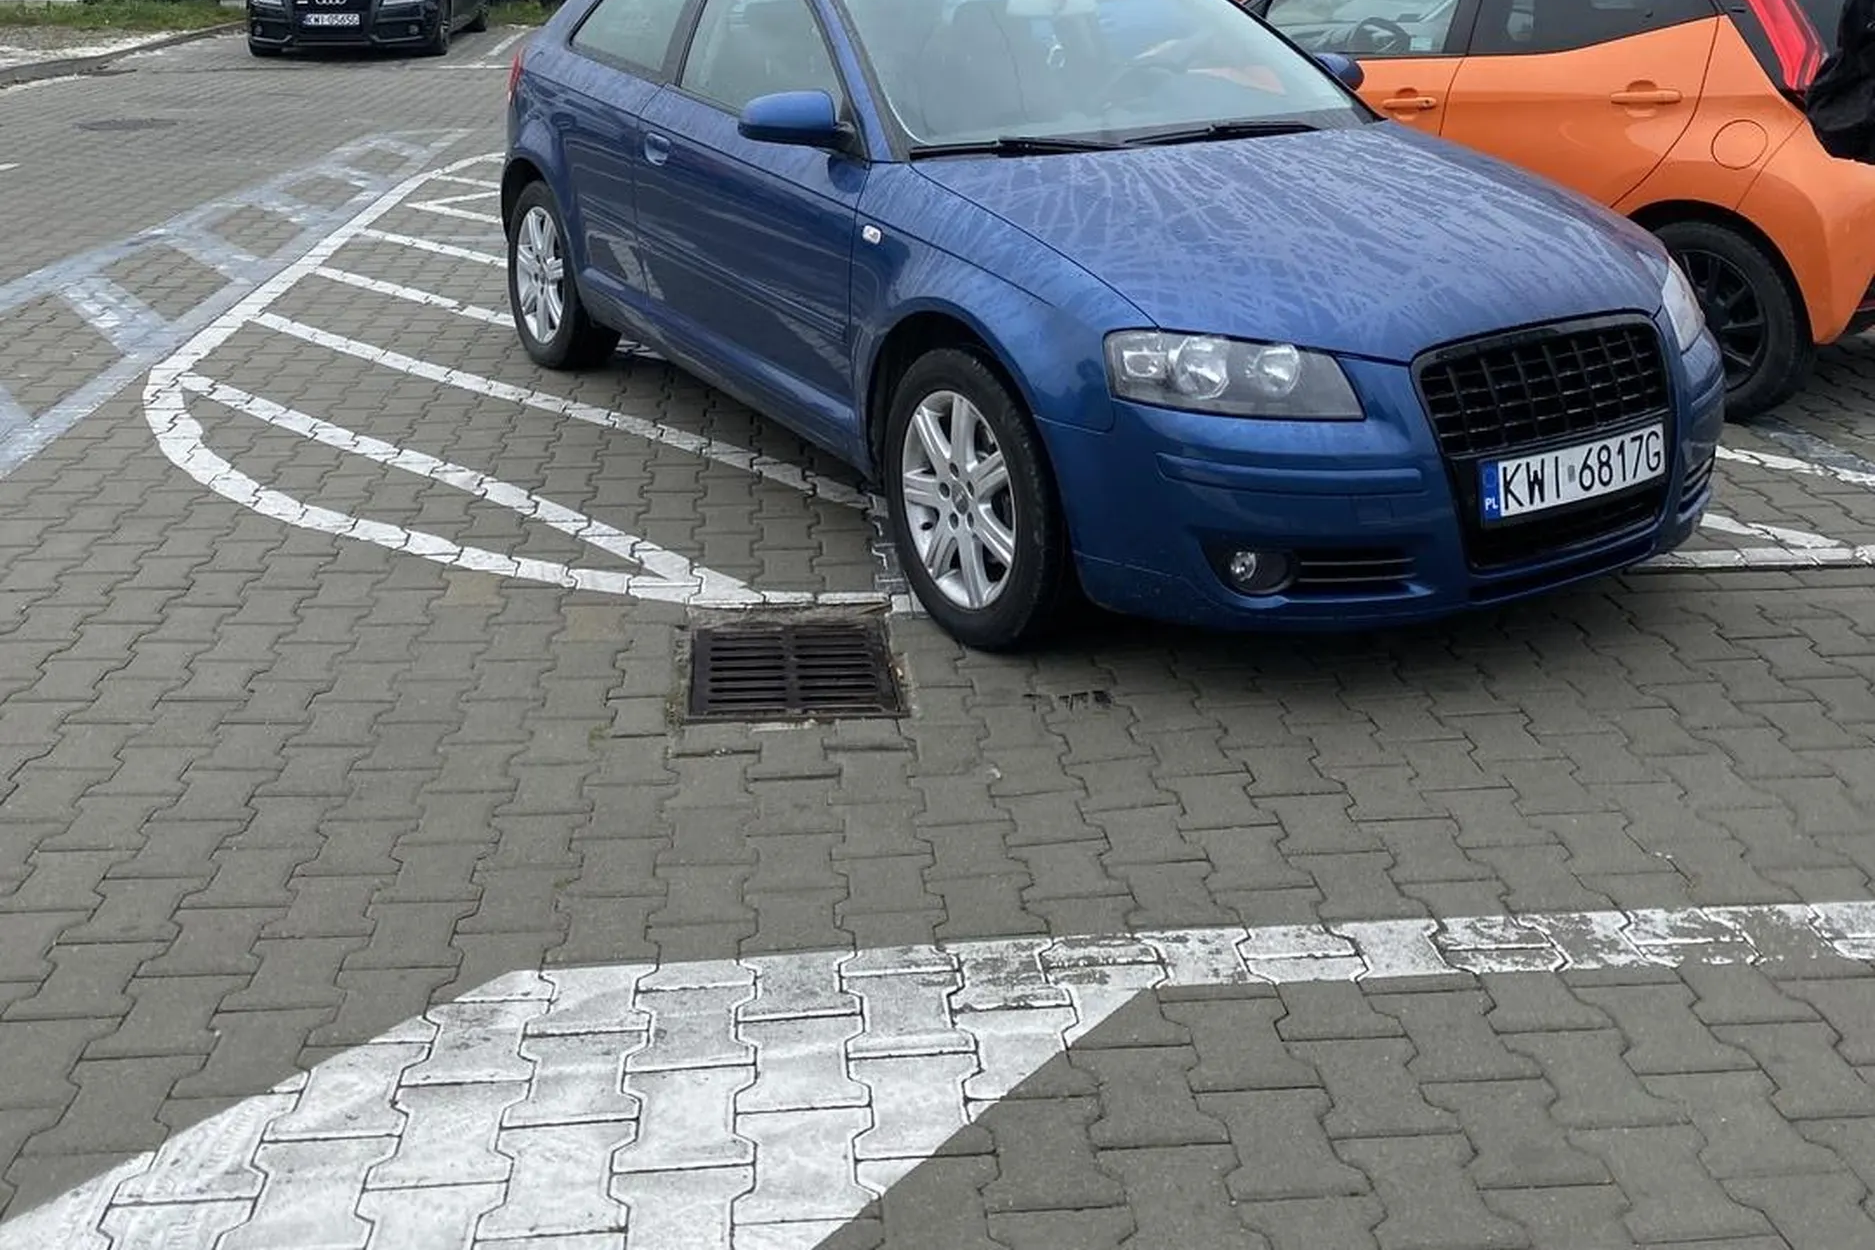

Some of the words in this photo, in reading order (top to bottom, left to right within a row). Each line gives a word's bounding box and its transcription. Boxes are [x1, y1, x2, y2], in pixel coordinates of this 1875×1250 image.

[1503, 456, 1561, 510] KWI
[1579, 431, 1662, 492] 6817G
[1484, 497, 1499, 511] PL
